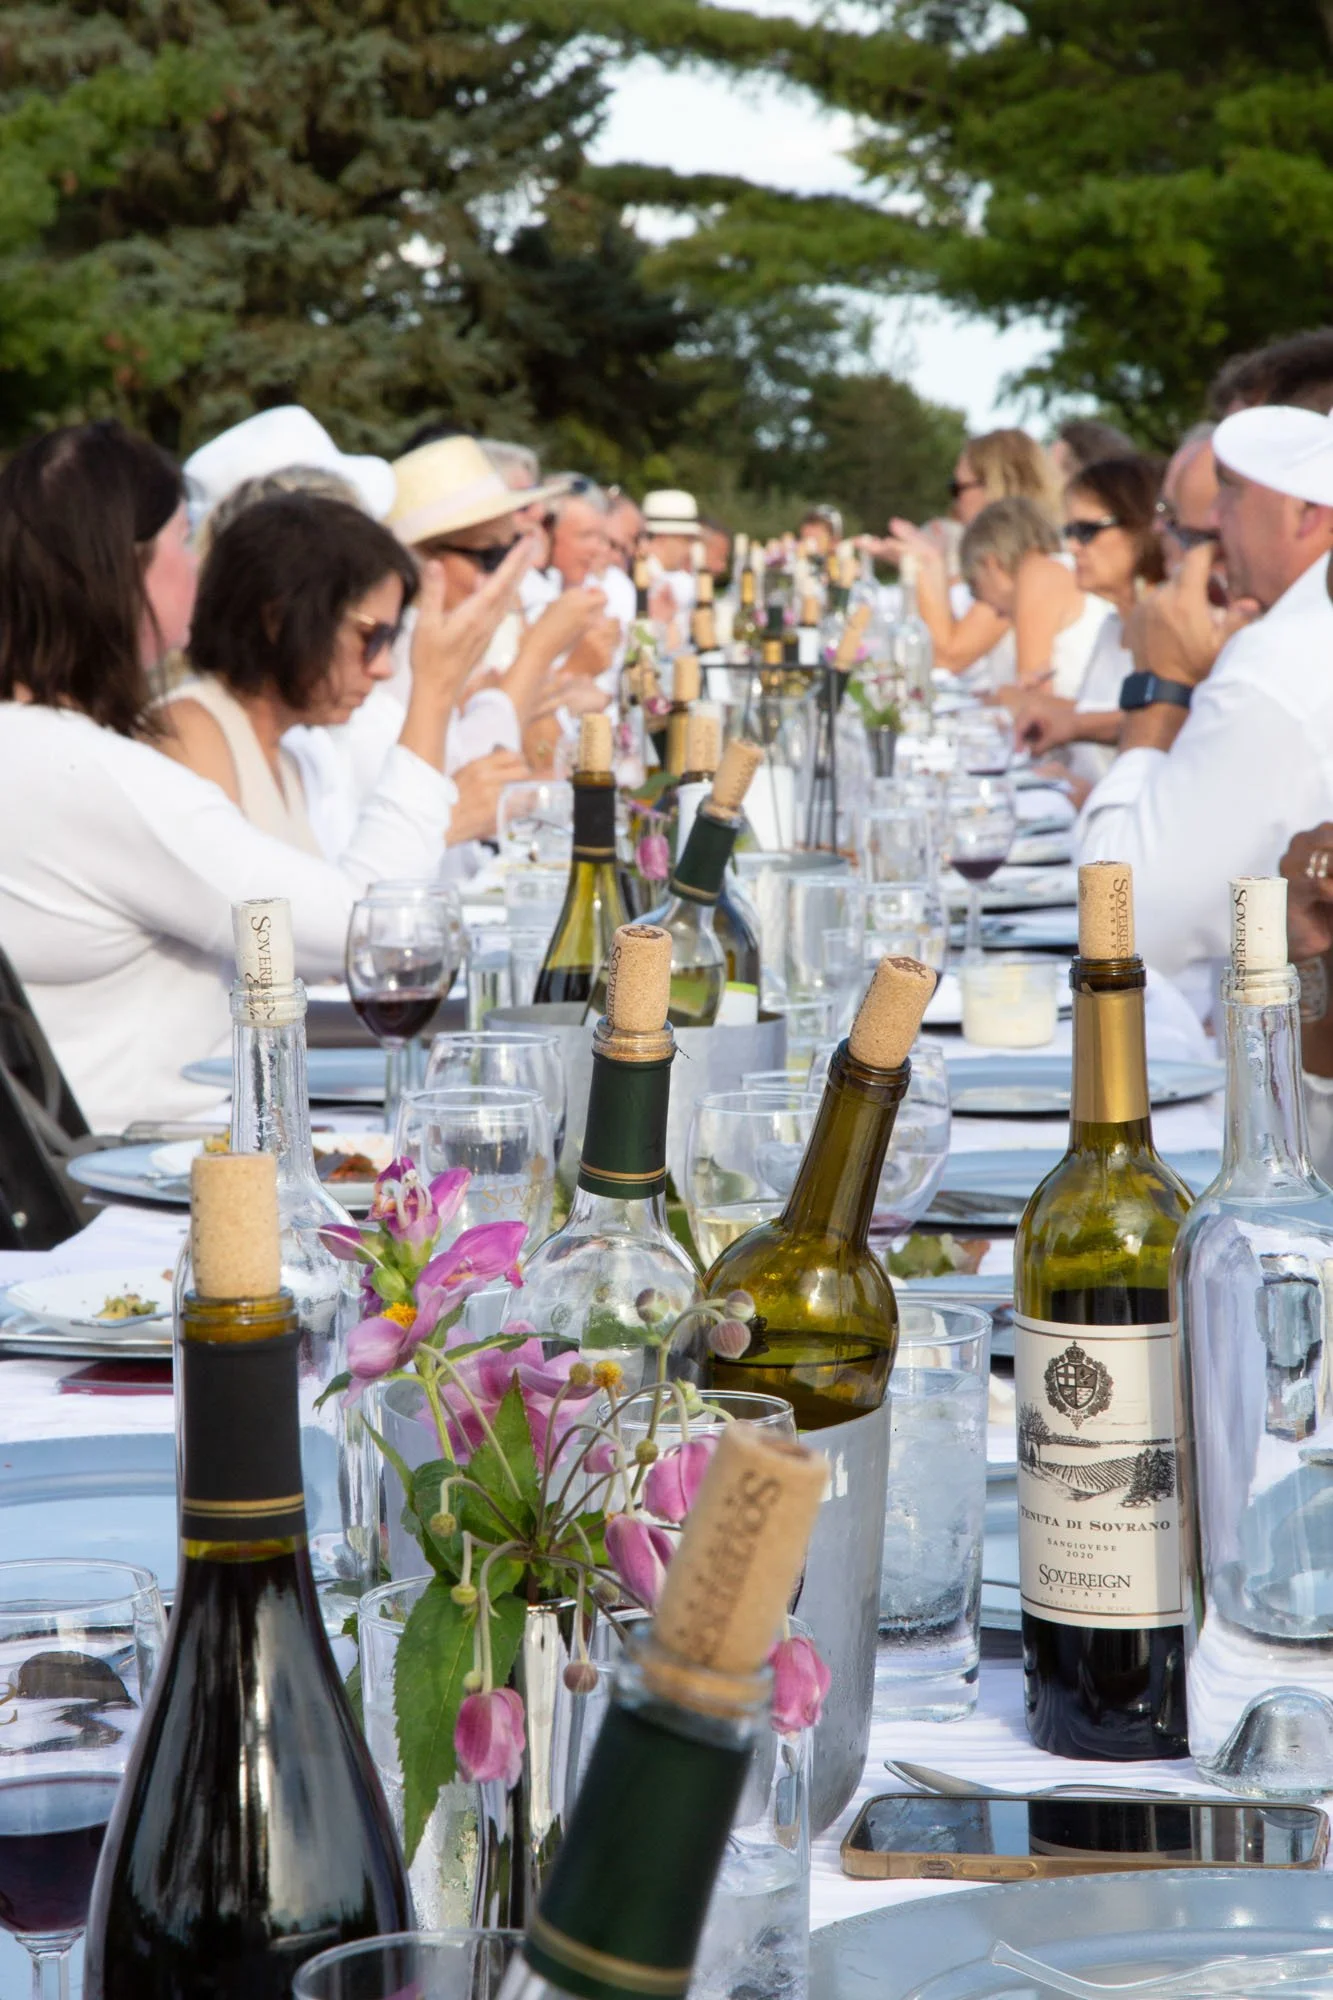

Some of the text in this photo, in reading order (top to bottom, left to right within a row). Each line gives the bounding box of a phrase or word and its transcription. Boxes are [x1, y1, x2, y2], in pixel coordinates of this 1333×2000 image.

[1020, 1505, 1171, 1532] TENUTA DI SOVRANO
[1047, 1537, 1117, 1551] SANGIOVESE
[1066, 1550, 1094, 1560] 2020
[1039, 1563, 1132, 1590] SOVEREIGN
